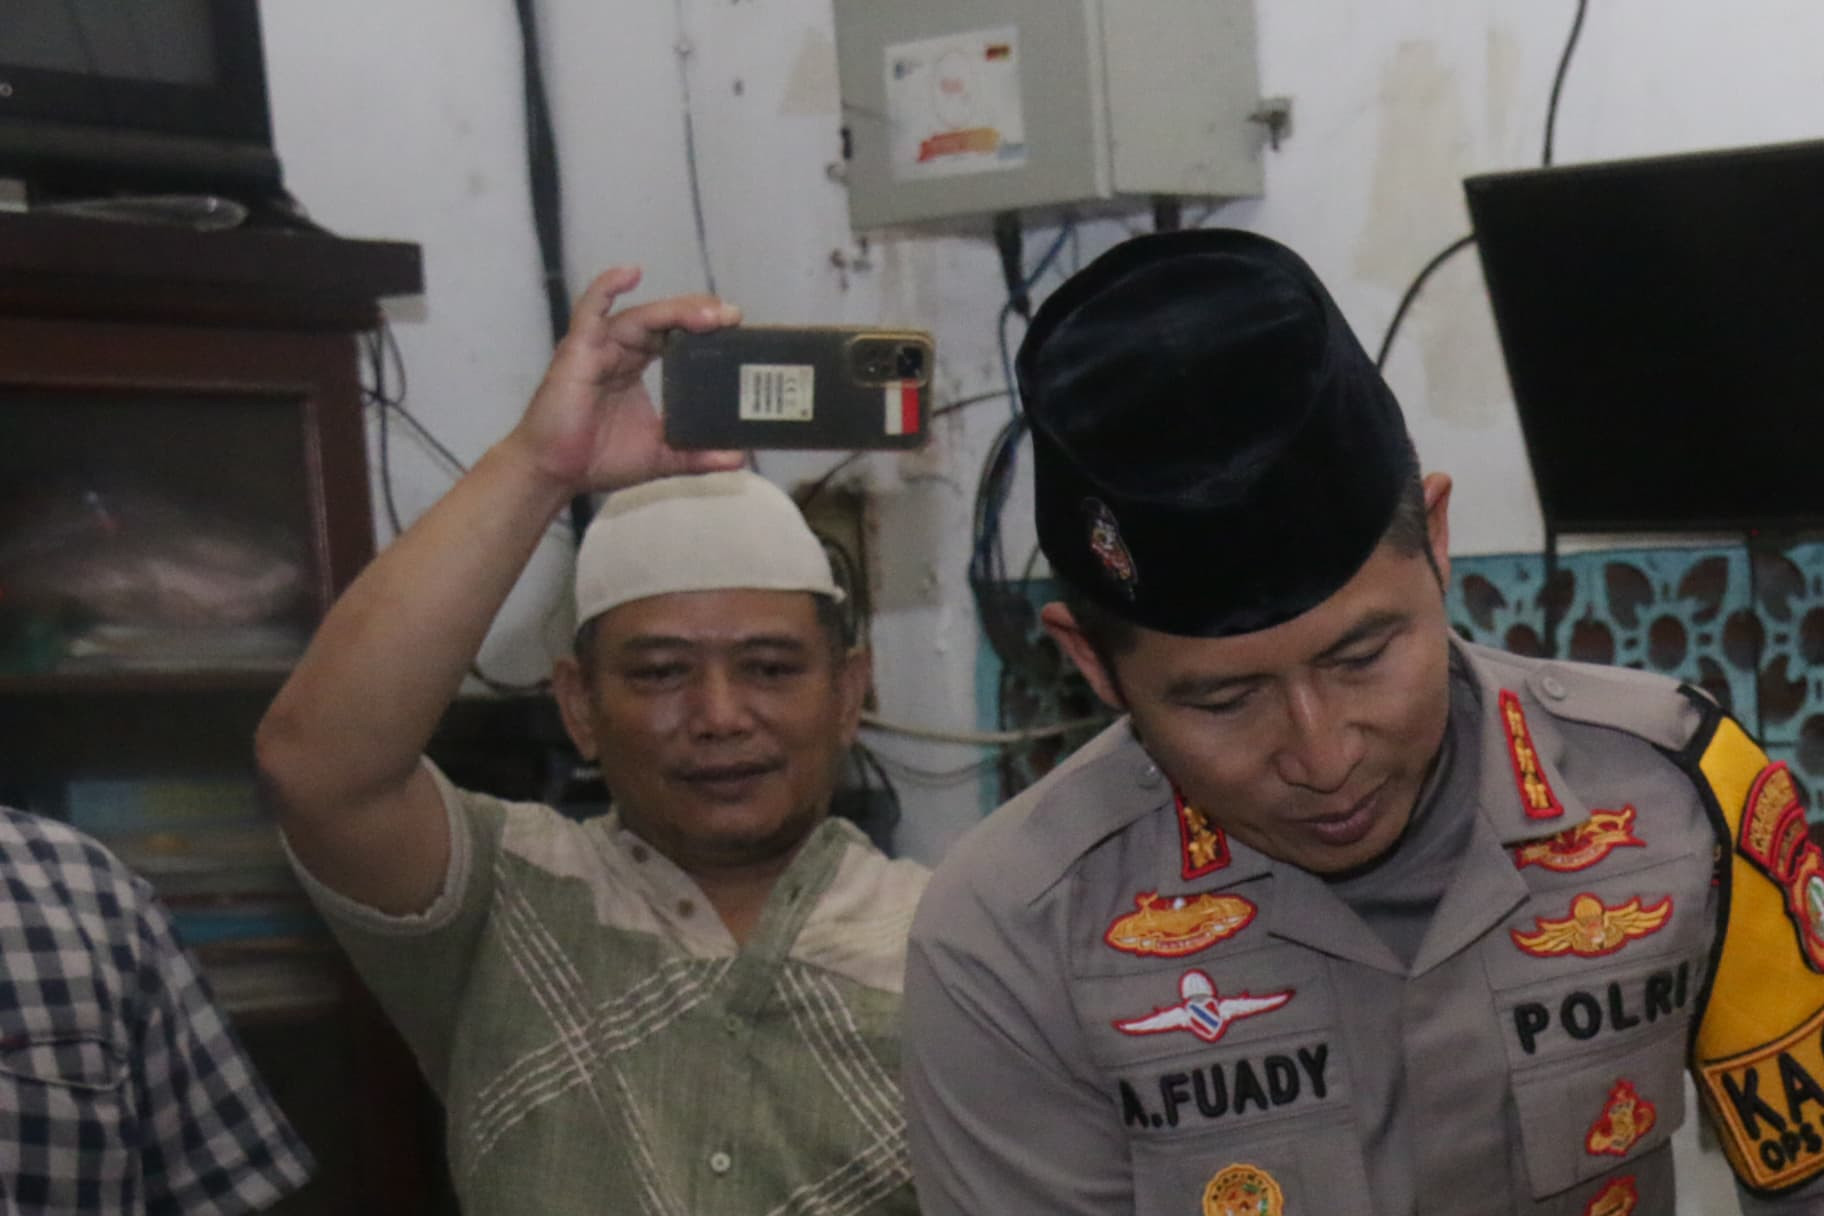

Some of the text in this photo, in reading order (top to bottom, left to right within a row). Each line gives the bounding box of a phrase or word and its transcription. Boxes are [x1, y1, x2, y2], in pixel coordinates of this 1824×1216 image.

[1514, 960, 1690, 1055] POLRI
[1118, 1043, 1328, 1128] A.FUADY
[1759, 1121, 1823, 1171] OPS
